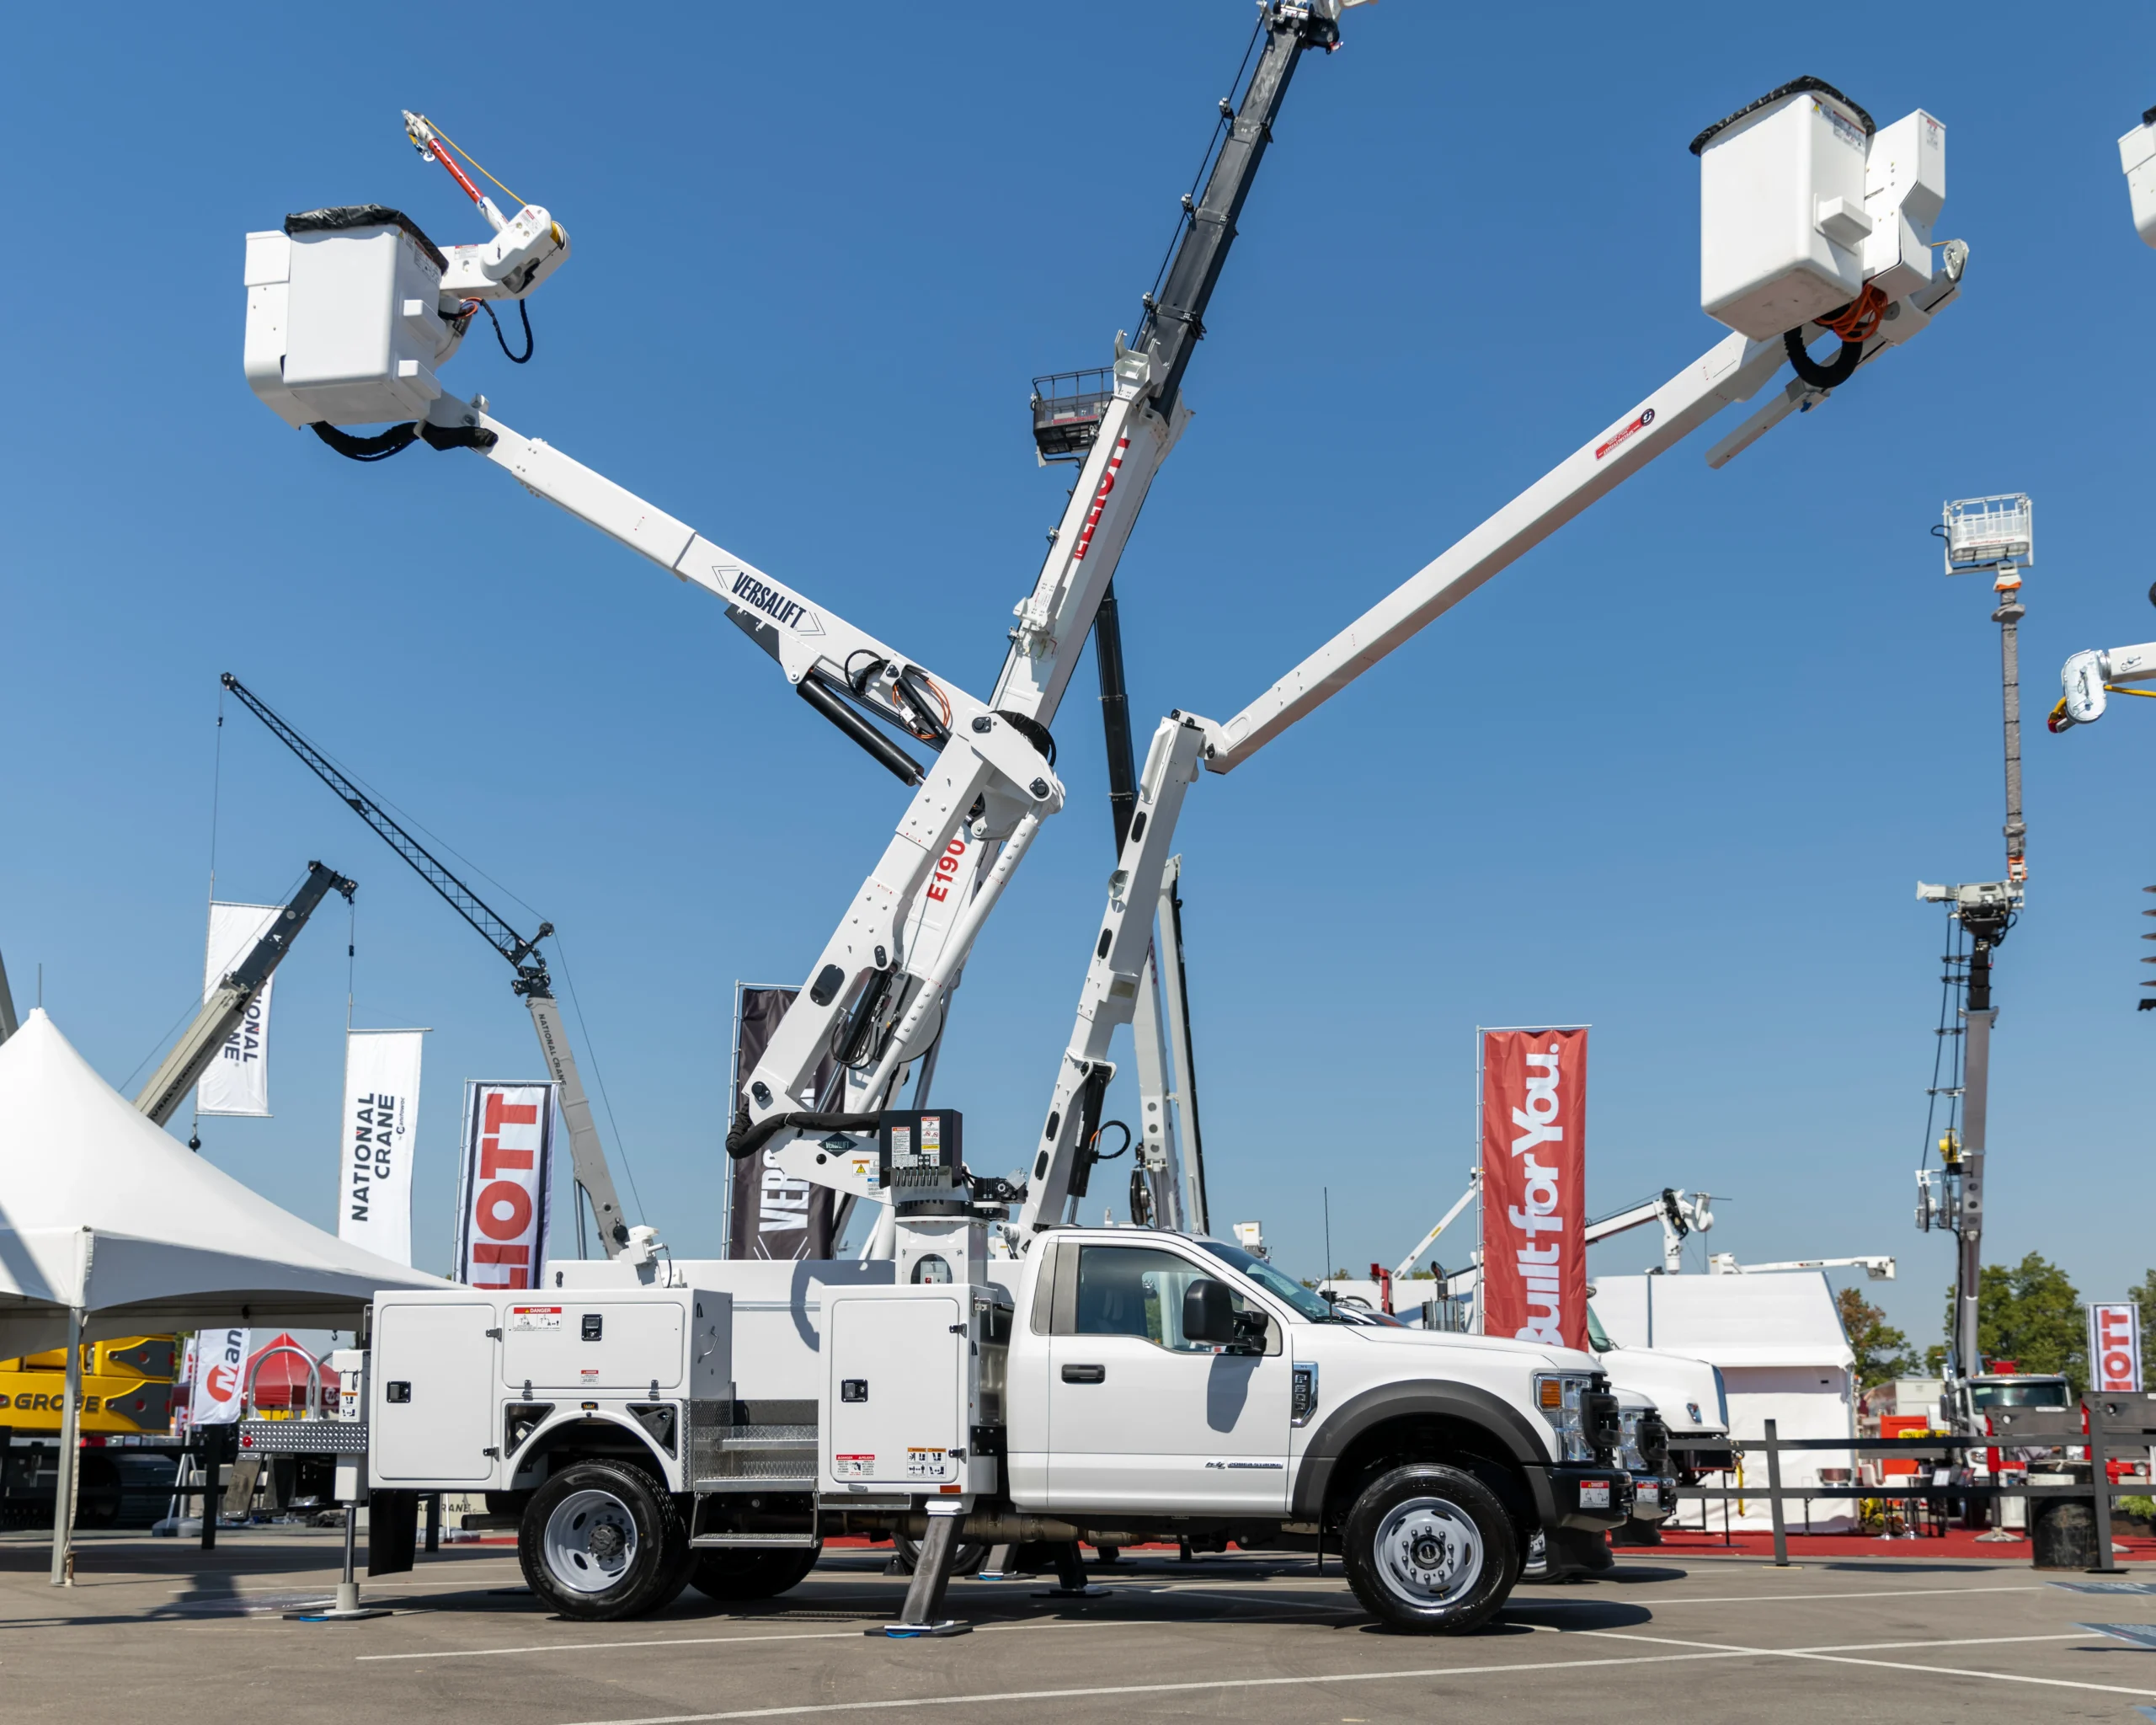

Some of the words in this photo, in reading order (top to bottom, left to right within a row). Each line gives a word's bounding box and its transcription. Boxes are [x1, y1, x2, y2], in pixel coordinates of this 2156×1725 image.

[731, 571, 807, 628] VERSALIFT
[926, 839, 966, 903] E190
[538, 1013, 557, 1056] NATIONAL
[552, 1057, 567, 1086] CRANE
[374, 1094, 395, 1179] CRANE
[1511, 1043, 1563, 1157] You.
[351, 1092, 375, 1222] NATIONAL
[825, 1140, 850, 1149] VERSALIFT
[472, 1093, 537, 1290] LIOTT
[1508, 1153, 1563, 1238] for
[2100, 1309, 2132, 1391] IOTT
